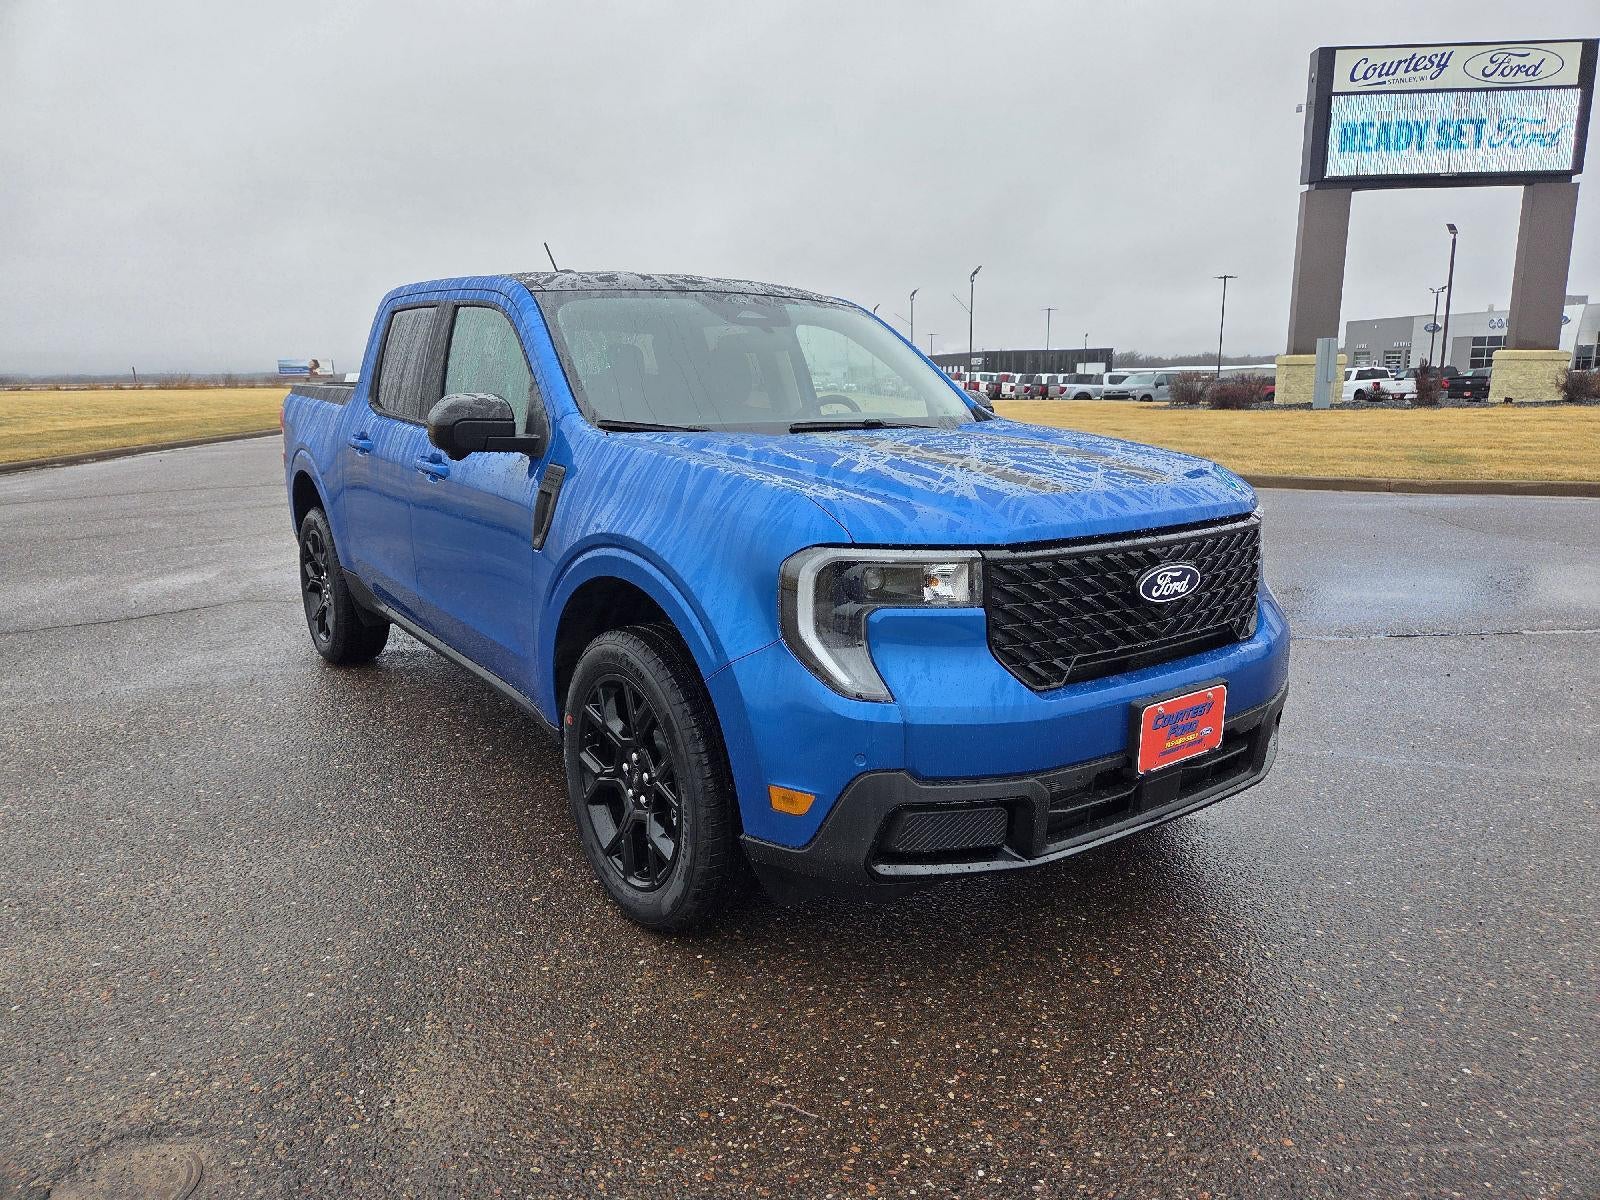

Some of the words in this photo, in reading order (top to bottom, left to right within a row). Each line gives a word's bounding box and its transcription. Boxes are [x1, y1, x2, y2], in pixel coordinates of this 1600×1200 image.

[1349, 50, 1454, 82] Courtesy
[1481, 52, 1546, 77] Ford
[1387, 76, 1418, 84] STANLEY,
[1339, 119, 1430, 153] READY
[1435, 117, 1487, 151] SET
[1487, 116, 1572, 149] Ford
[1152, 571, 1191, 597] Ford
